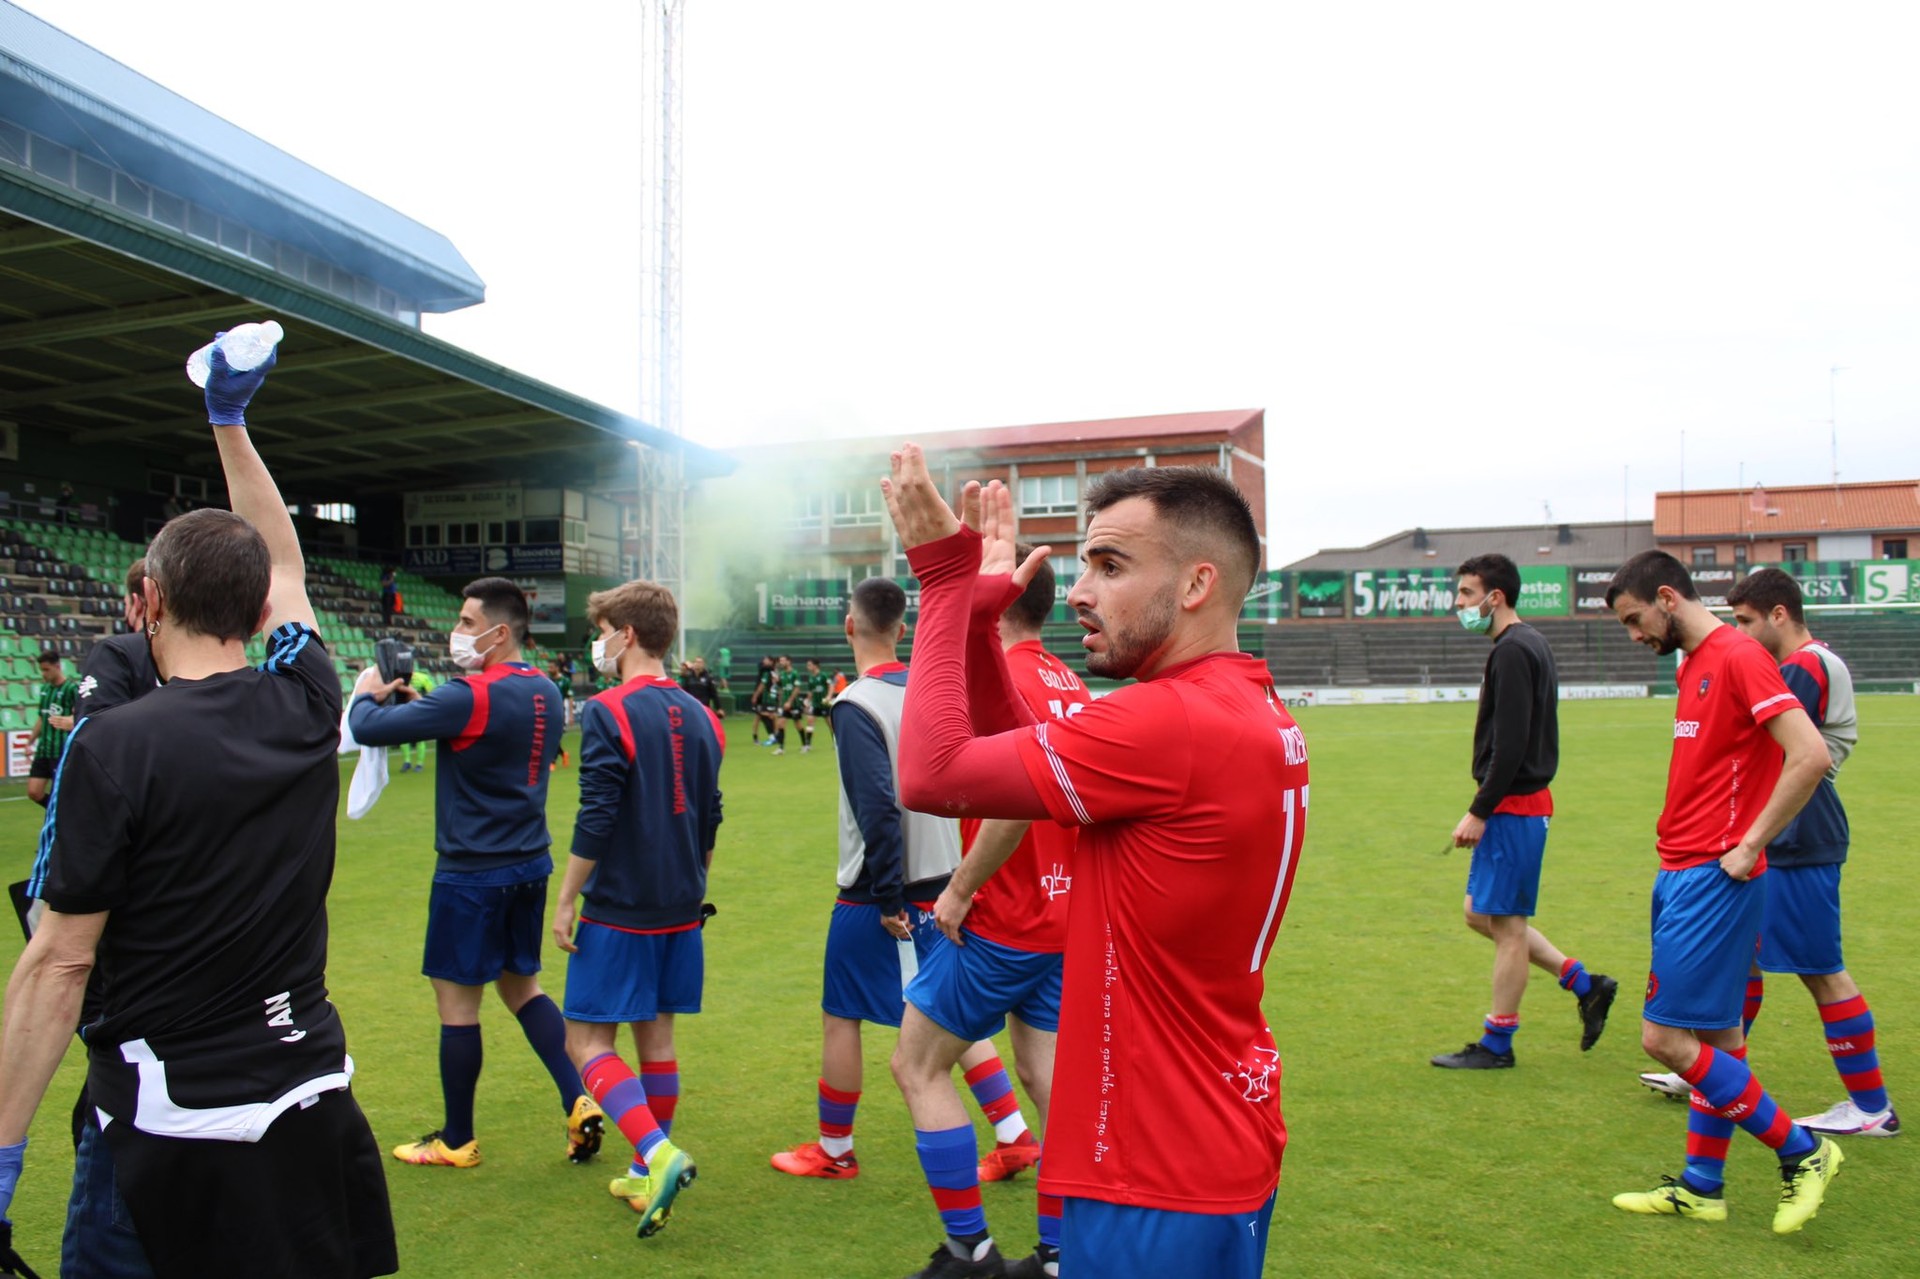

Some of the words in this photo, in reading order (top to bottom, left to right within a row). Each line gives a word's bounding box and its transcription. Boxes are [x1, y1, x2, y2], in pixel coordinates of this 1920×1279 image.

[407, 550, 450, 566] ARD
[771, 594, 845, 606] Rehanor
[1353, 571, 1375, 616] 5
[1565, 685, 1646, 699] kutxabank
[671, 733, 688, 815] ANAITASUNA
[1105, 942, 1119, 989] zirelako
[1101, 992, 1111, 1018] gara
[1103, 1023, 1112, 1043] eta
[1099, 1046, 1115, 1095] garelako
[1095, 1100, 1112, 1136] izango
[1094, 1141, 1109, 1162] dira
